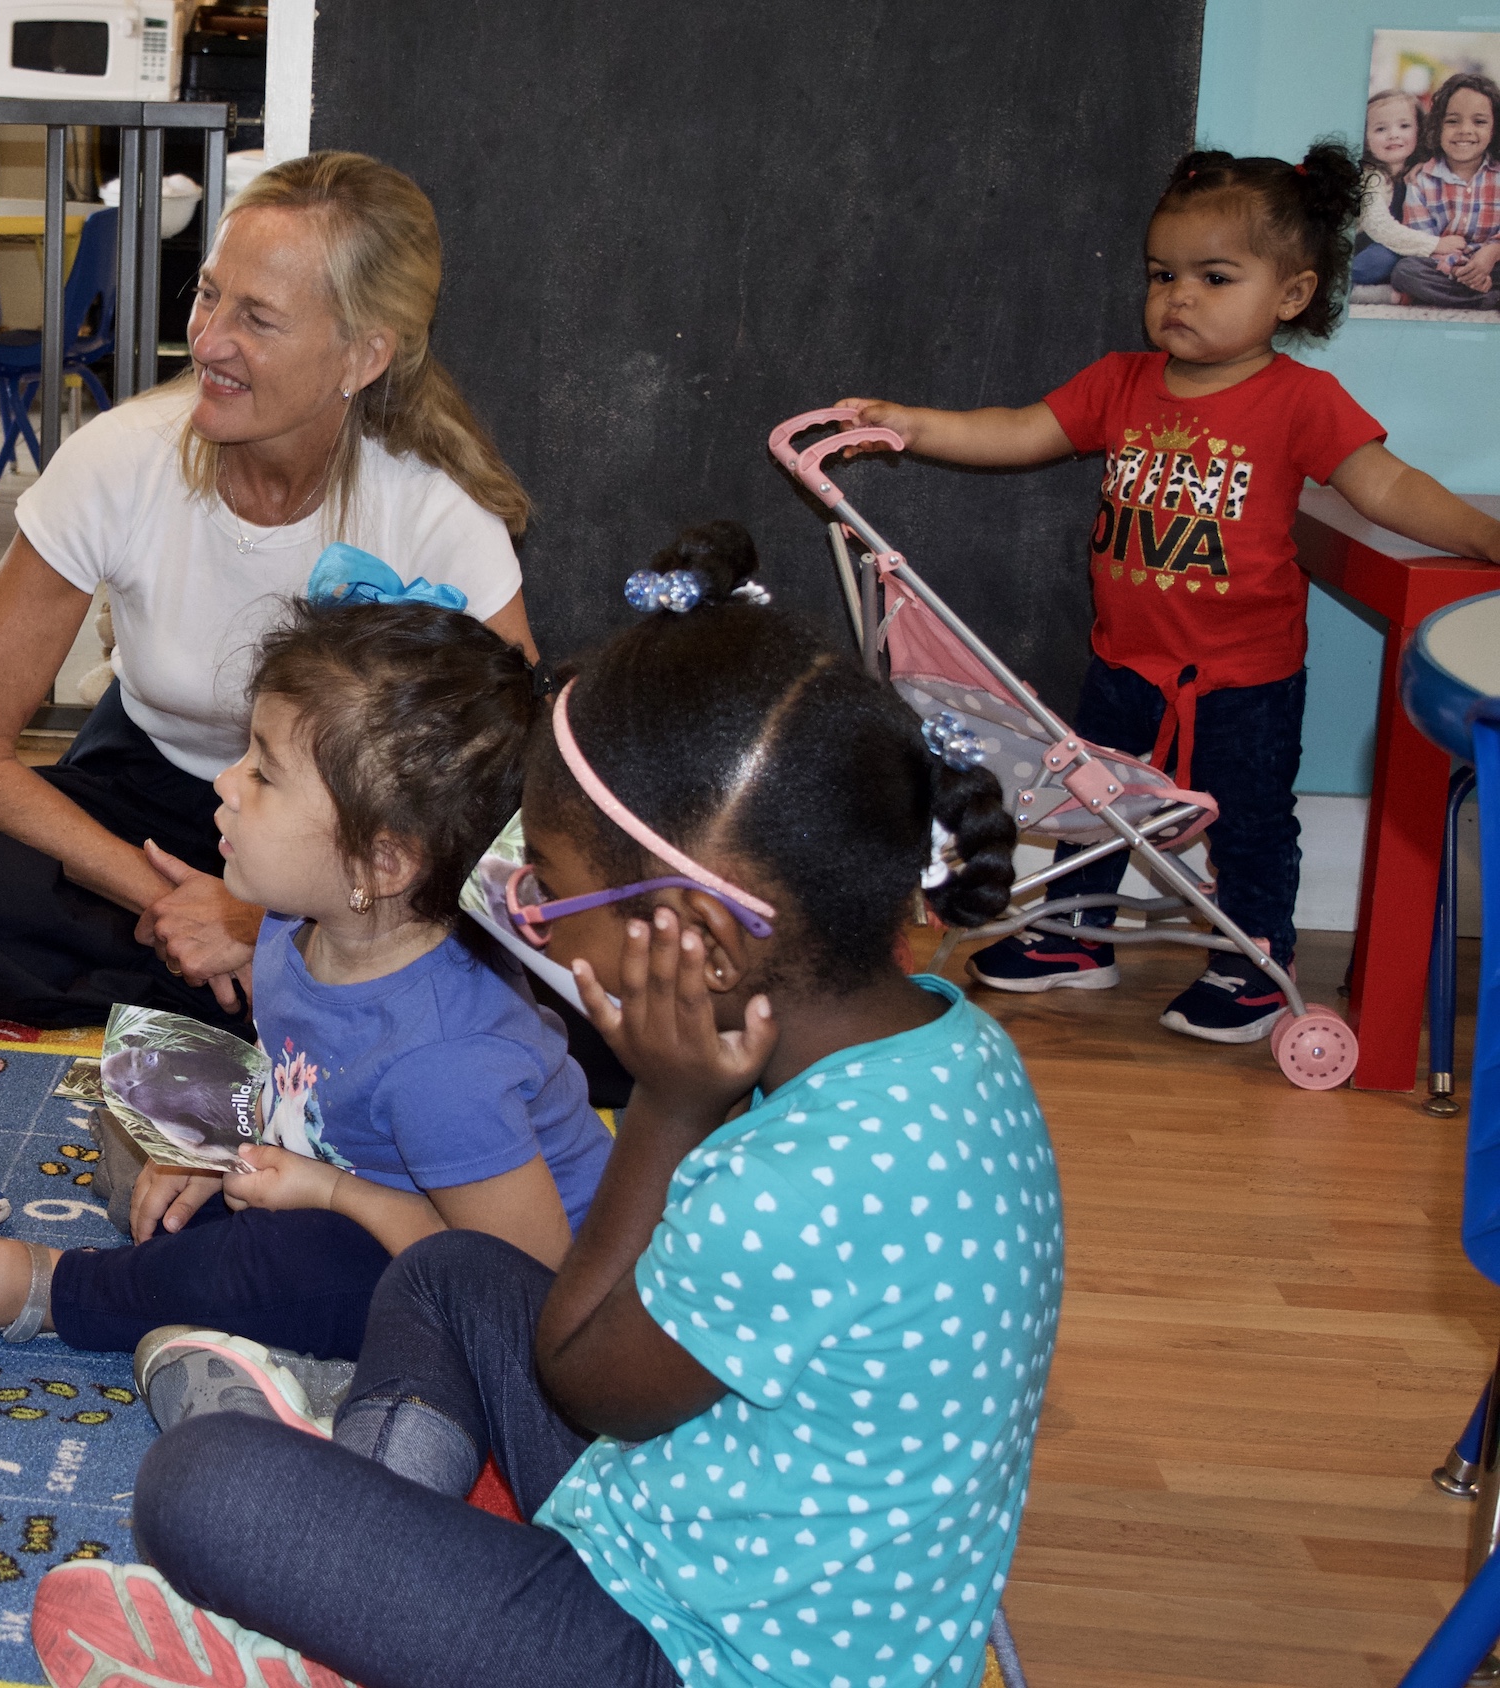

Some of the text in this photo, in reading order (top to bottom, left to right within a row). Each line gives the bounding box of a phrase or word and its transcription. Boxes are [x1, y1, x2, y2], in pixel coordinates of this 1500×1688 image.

[1101, 444, 1253, 521] MINI
[1091, 499, 1229, 576] DIVA
[231, 1084, 253, 1137] Gorilla
[46, 1438, 88, 1493] seven
